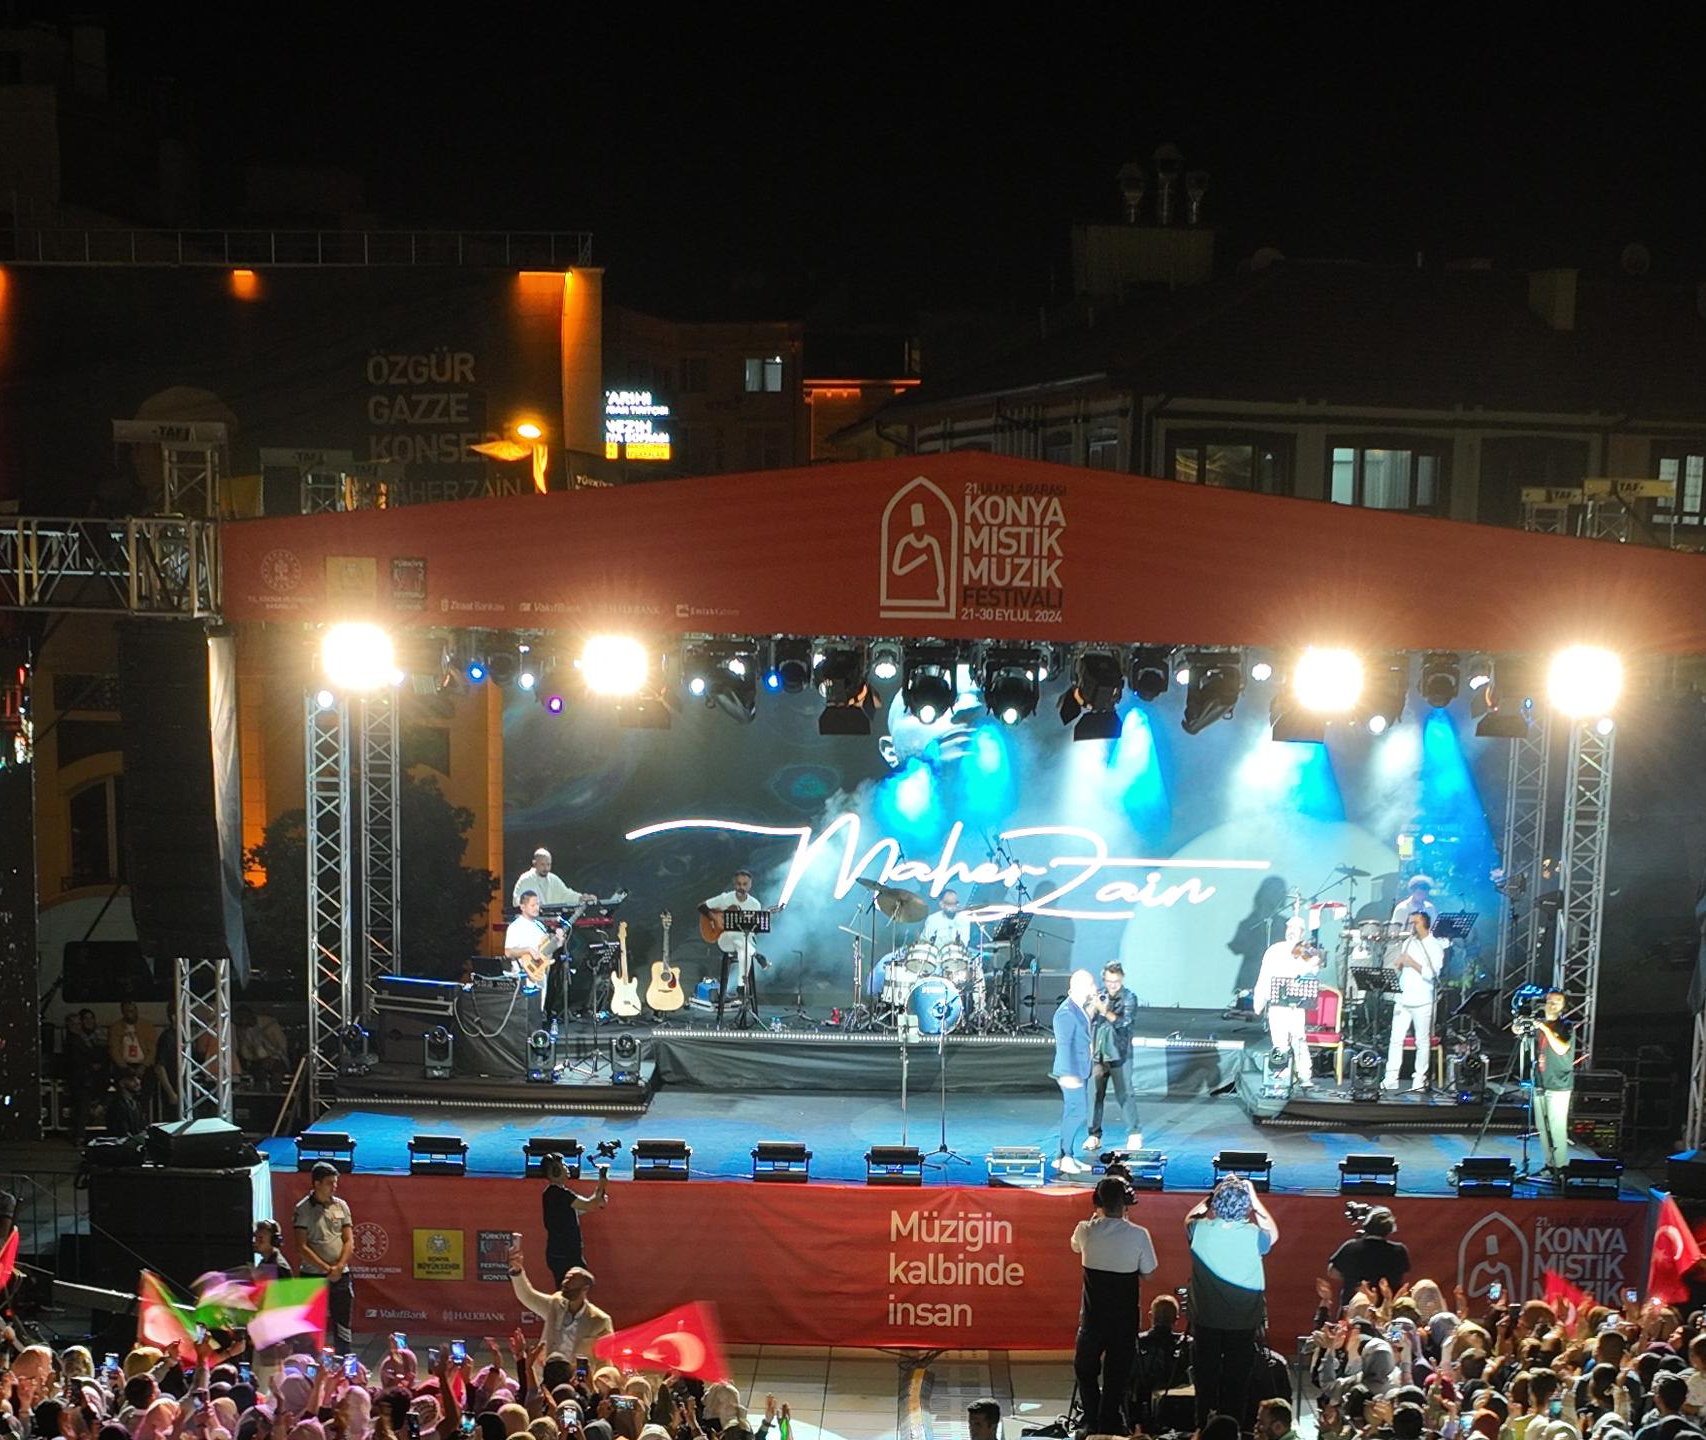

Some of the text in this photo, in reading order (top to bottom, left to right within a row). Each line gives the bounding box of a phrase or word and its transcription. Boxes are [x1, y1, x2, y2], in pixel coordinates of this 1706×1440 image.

[366, 347, 475, 384] ÖZGÜR
[367, 393, 469, 425] GAZZE
[964, 482, 981, 495] 21.
[964, 495, 1068, 527] KONYA
[961, 607, 994, 620] 21-30
[1035, 610, 1063, 623] 2024
[890, 1210, 1013, 1252] Müziğin
[1534, 1227, 1629, 1254] KONYA
[889, 1252, 1025, 1286] kalbinde
[888, 1294, 973, 1328] insan
